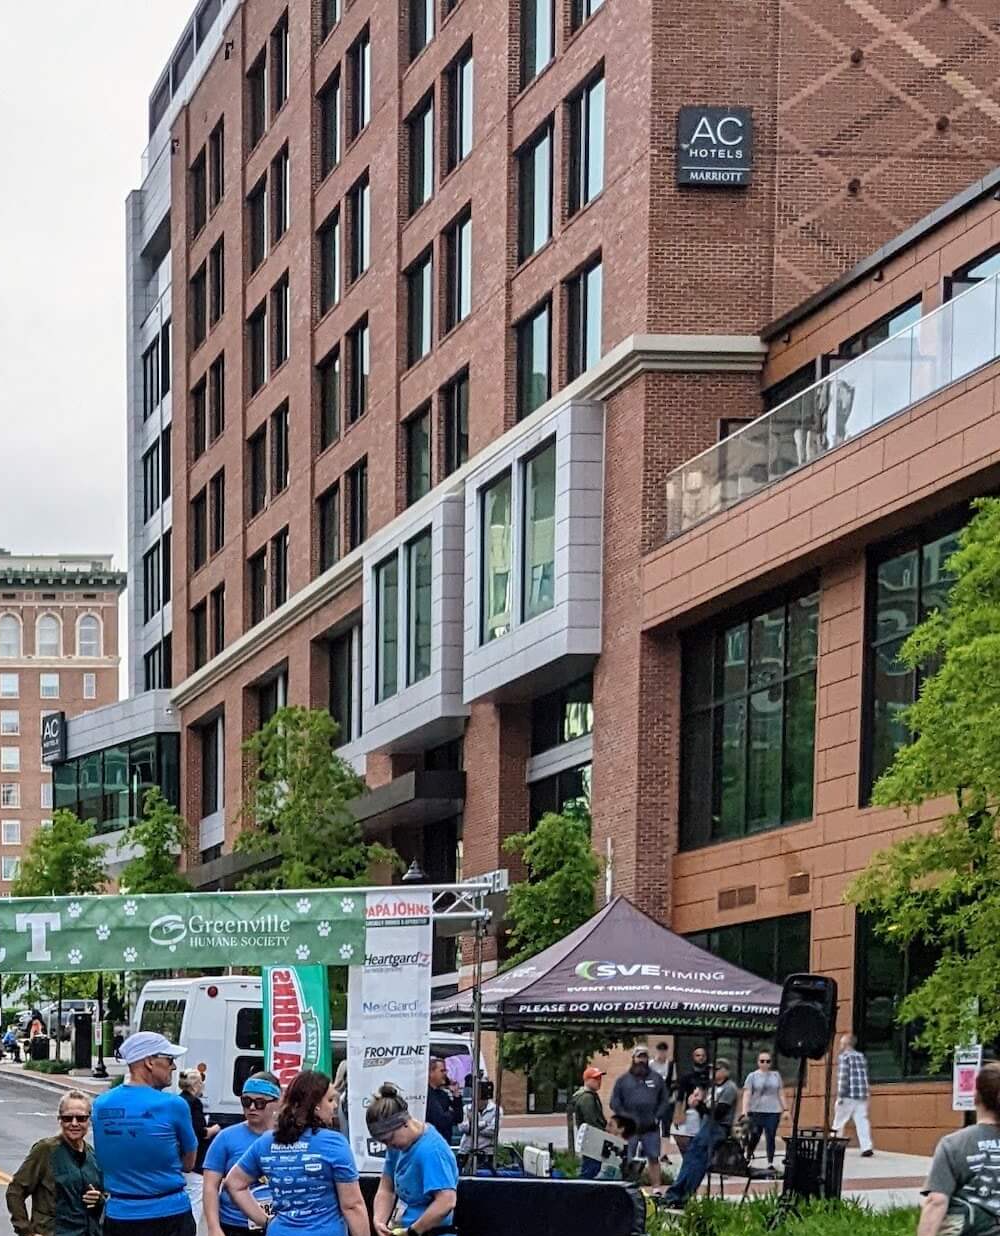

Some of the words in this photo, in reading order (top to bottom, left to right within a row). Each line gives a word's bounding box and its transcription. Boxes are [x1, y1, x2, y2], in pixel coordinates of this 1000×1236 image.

[690, 117, 743, 146] AC
[689, 149, 743, 159] HOTELS
[690, 171, 743, 182] MARRIOTT
[43, 719, 59, 740] AC
[392, 902, 430, 916] JOHNS
[188, 914, 290, 934] Greenville
[190, 937, 238, 947] HUMANE
[240, 936, 290, 946] SOCIETY
[364, 952, 420, 967] Heartgard
[596, 964, 662, 977] SVE
[661, 969, 726, 981] TIMING
[518, 1002, 566, 1013] PLEASE
[569, 1002, 590, 1012] DO
[593, 1001, 622, 1011] NOT
[624, 1000, 678, 1011] DISTURB
[682, 1001, 729, 1013] TIMING
[731, 1004, 781, 1015] DURING
[627, 1016, 645, 1024] at
[364, 1045, 425, 1058] FRONTLINE
